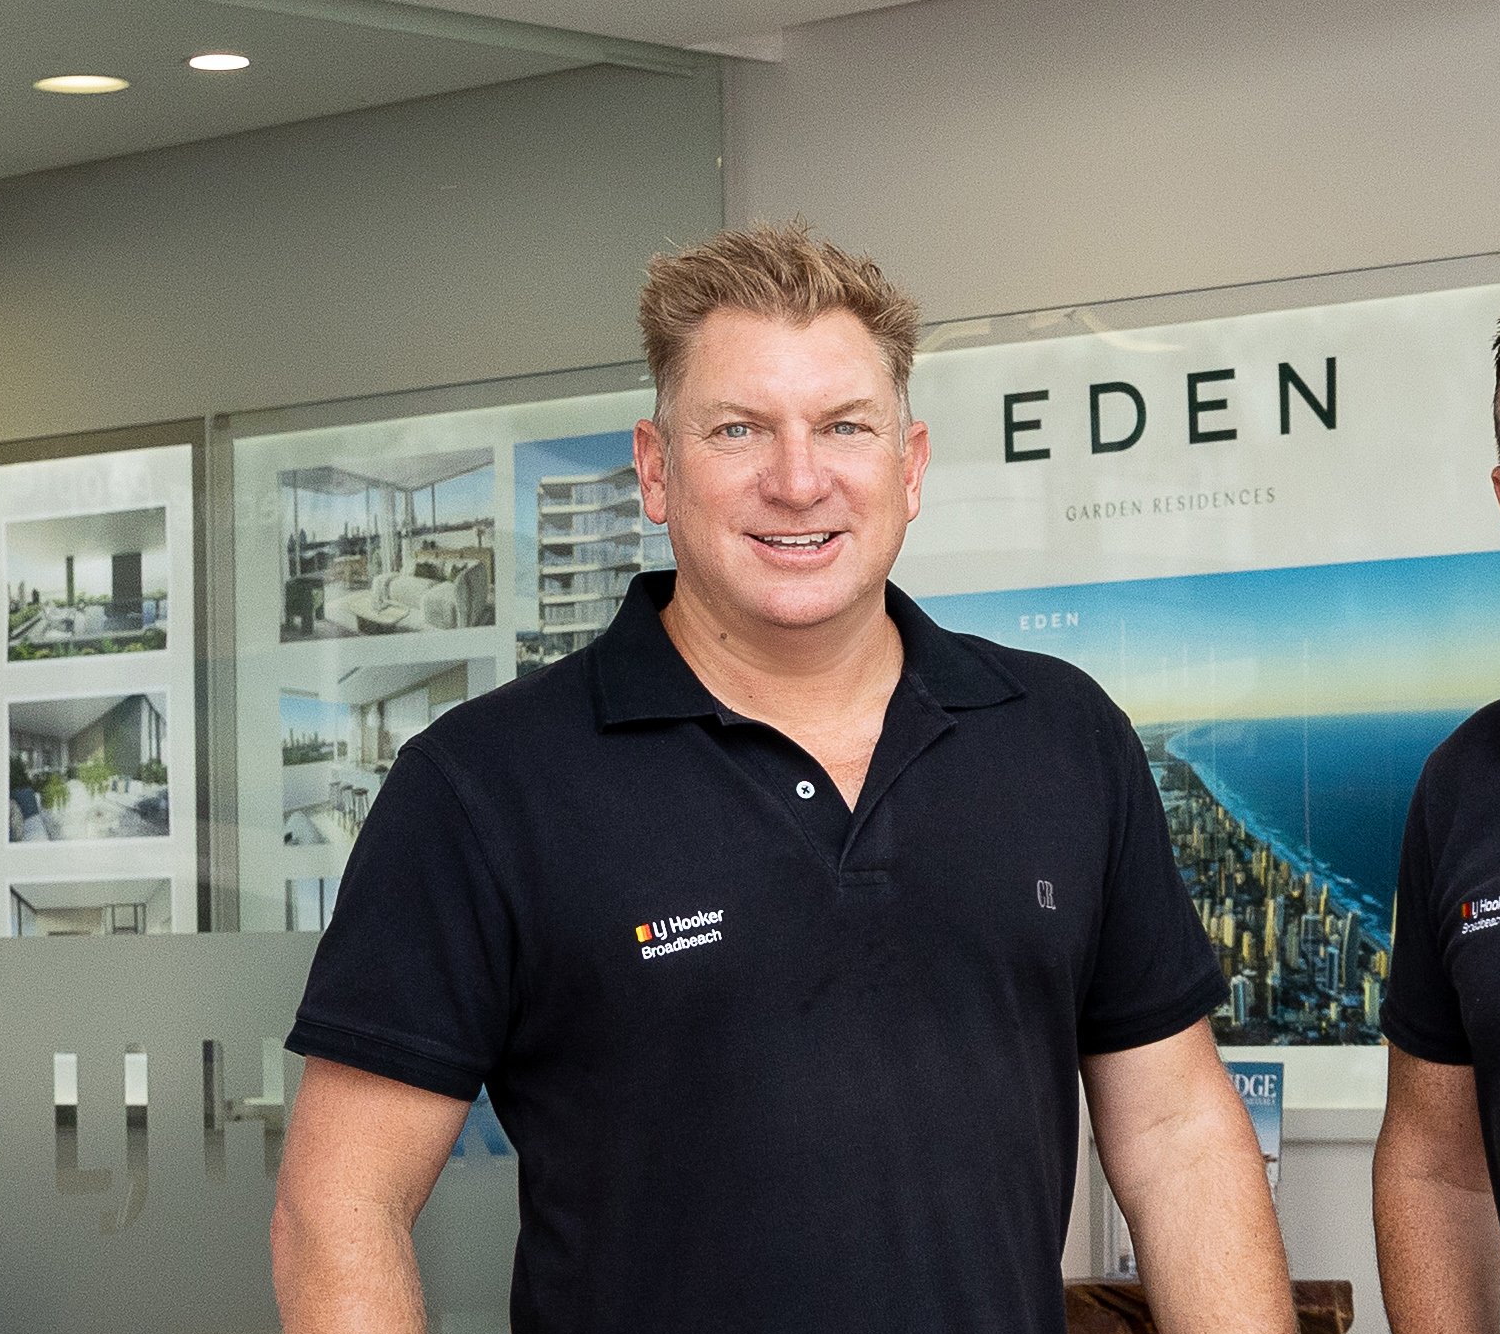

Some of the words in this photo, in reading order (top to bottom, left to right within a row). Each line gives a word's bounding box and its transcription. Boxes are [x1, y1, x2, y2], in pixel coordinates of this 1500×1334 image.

[1004, 357, 1337, 463] EDEN
[1066, 498, 1142, 522] GARDEN
[1153, 487, 1276, 513] RESIDENCES
[1020, 612, 1080, 630] EDEN
[653, 920, 668, 940] LJ
[669, 910, 724, 933] Hooker
[642, 929, 722, 959] Broadbeach
[1231, 1074, 1277, 1097] DGE
